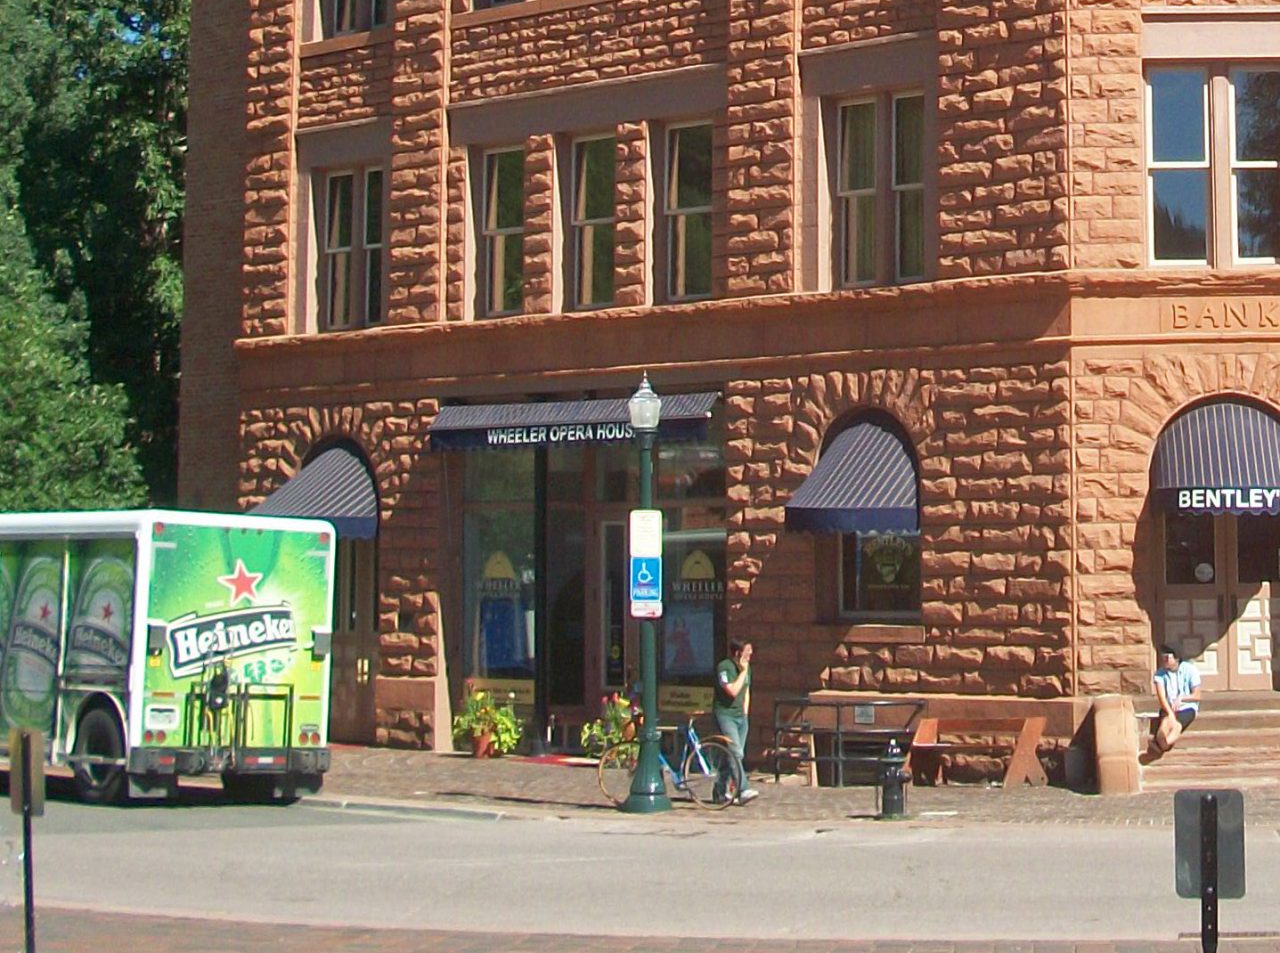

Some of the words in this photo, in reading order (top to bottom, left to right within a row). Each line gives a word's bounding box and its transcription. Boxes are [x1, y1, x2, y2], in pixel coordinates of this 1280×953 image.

[1172, 301, 1279, 329] BANK
[487, 428, 547, 445] WHEELER
[549, 425, 593, 442] OPERA
[596, 422, 636, 440] HOUS
[672, 581, 725, 593] WHEELER
